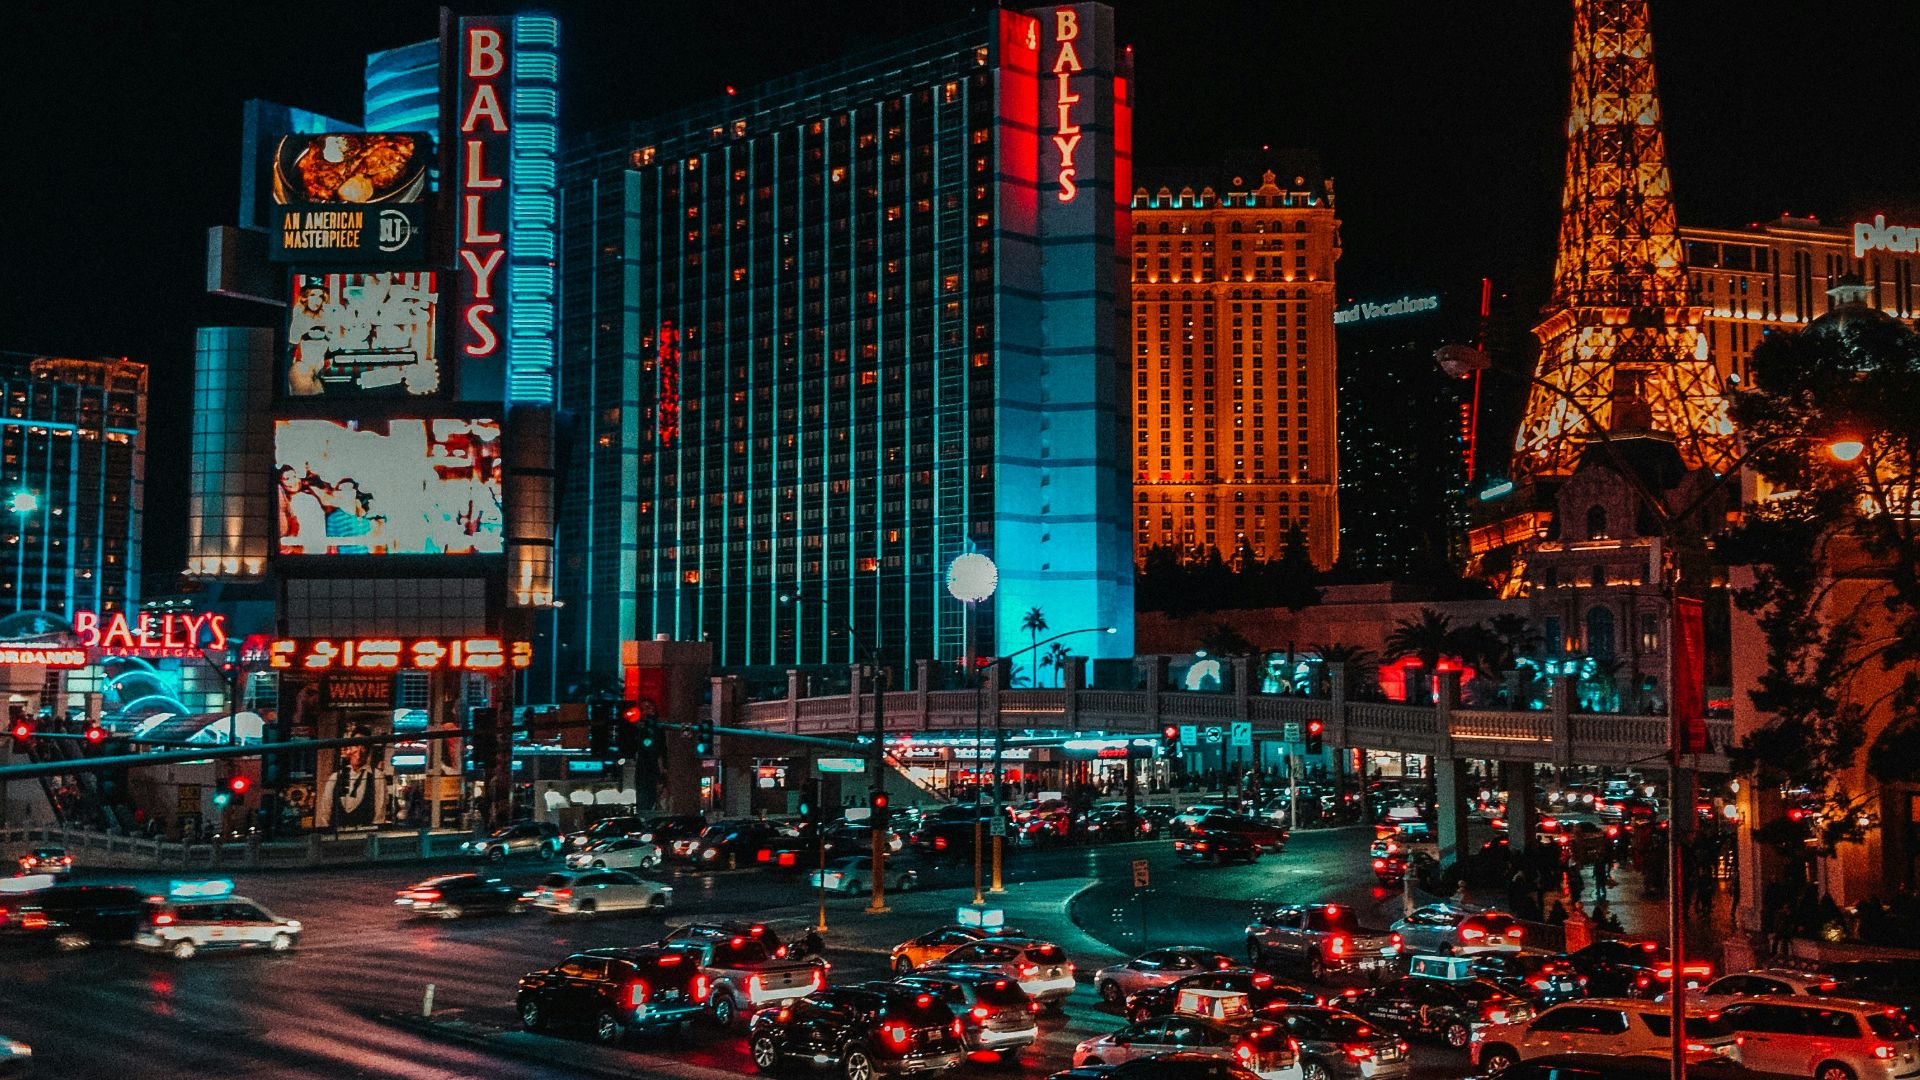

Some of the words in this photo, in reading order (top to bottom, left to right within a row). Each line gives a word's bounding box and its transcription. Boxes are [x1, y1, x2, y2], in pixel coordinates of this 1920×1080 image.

[1053, 10, 1082, 202] BALLYS
[460, 28, 509, 356] BALLYS
[284, 212, 300, 230] AN
[305, 211, 363, 229] AMERICAN
[284, 230, 360, 248] MASTERPIECE
[1361, 296, 1437, 319] Vacations
[76, 610, 226, 650] BALLY'S
[106, 648, 141, 657] LAS
[149, 648, 205, 658] VEGAS
[329, 683, 389, 699] WAYNE
